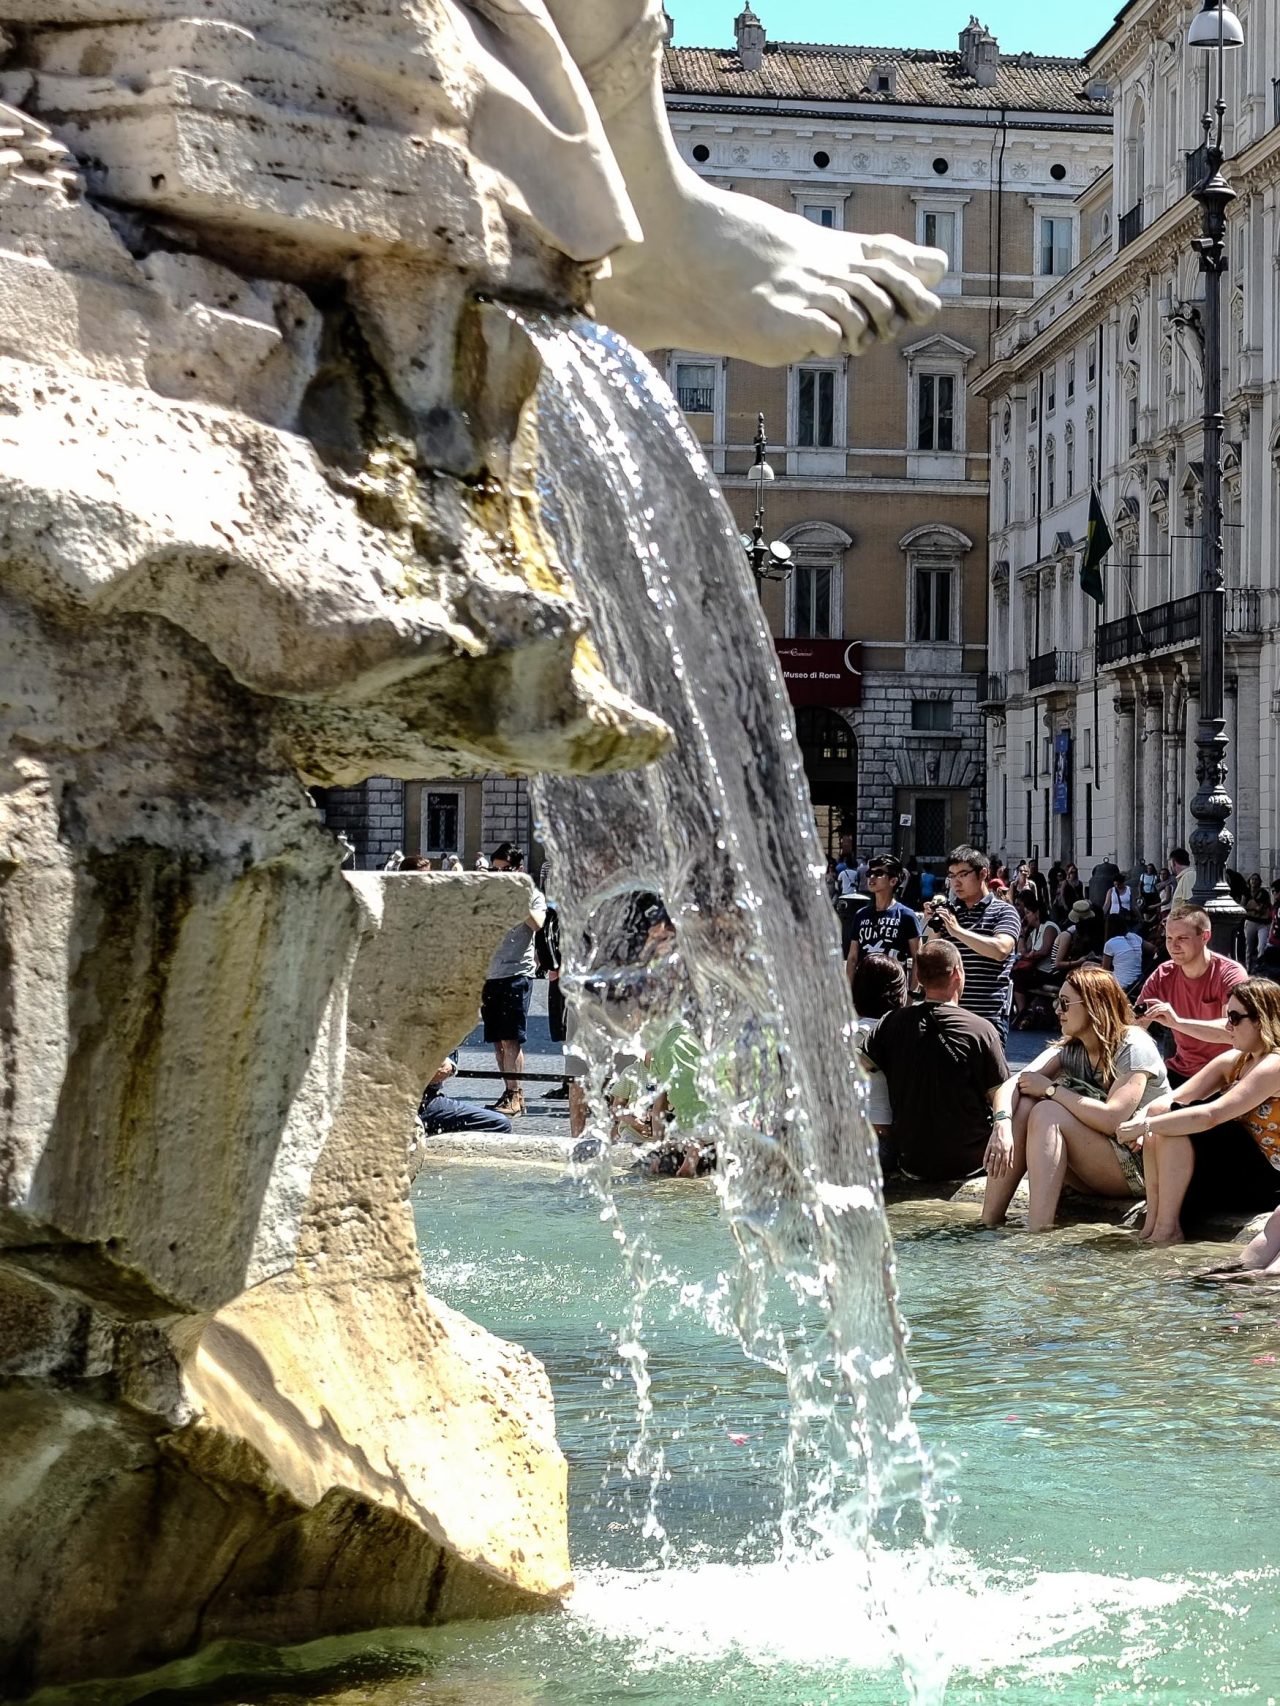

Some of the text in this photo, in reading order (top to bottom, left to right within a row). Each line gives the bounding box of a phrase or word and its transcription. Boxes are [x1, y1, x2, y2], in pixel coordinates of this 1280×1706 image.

[783, 671, 841, 680] Museo di Roma
